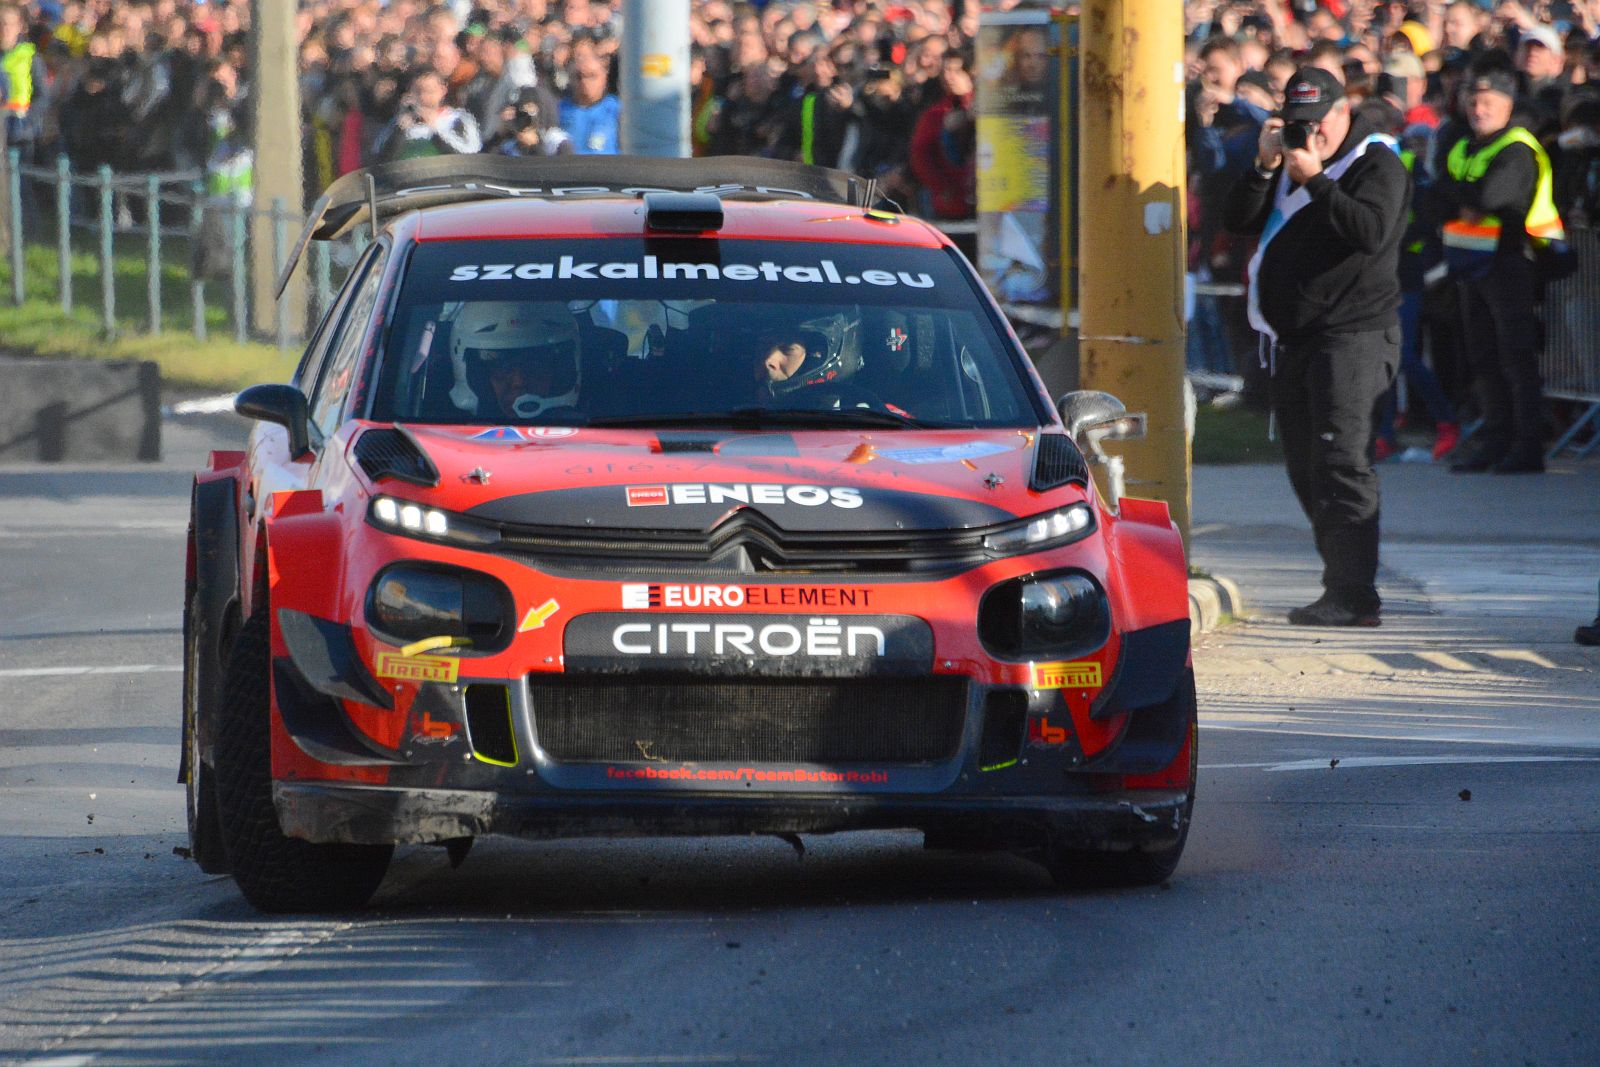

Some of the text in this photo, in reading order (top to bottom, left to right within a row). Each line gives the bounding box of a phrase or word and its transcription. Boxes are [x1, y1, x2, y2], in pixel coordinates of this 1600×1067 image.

[450, 256, 935, 288] szakalmetal.eu
[672, 484, 864, 509] ENEOS
[612, 618, 885, 657] CITROËN
[382, 655, 451, 681] PIRELLI
[1036, 666, 1098, 687] PIRELLI
